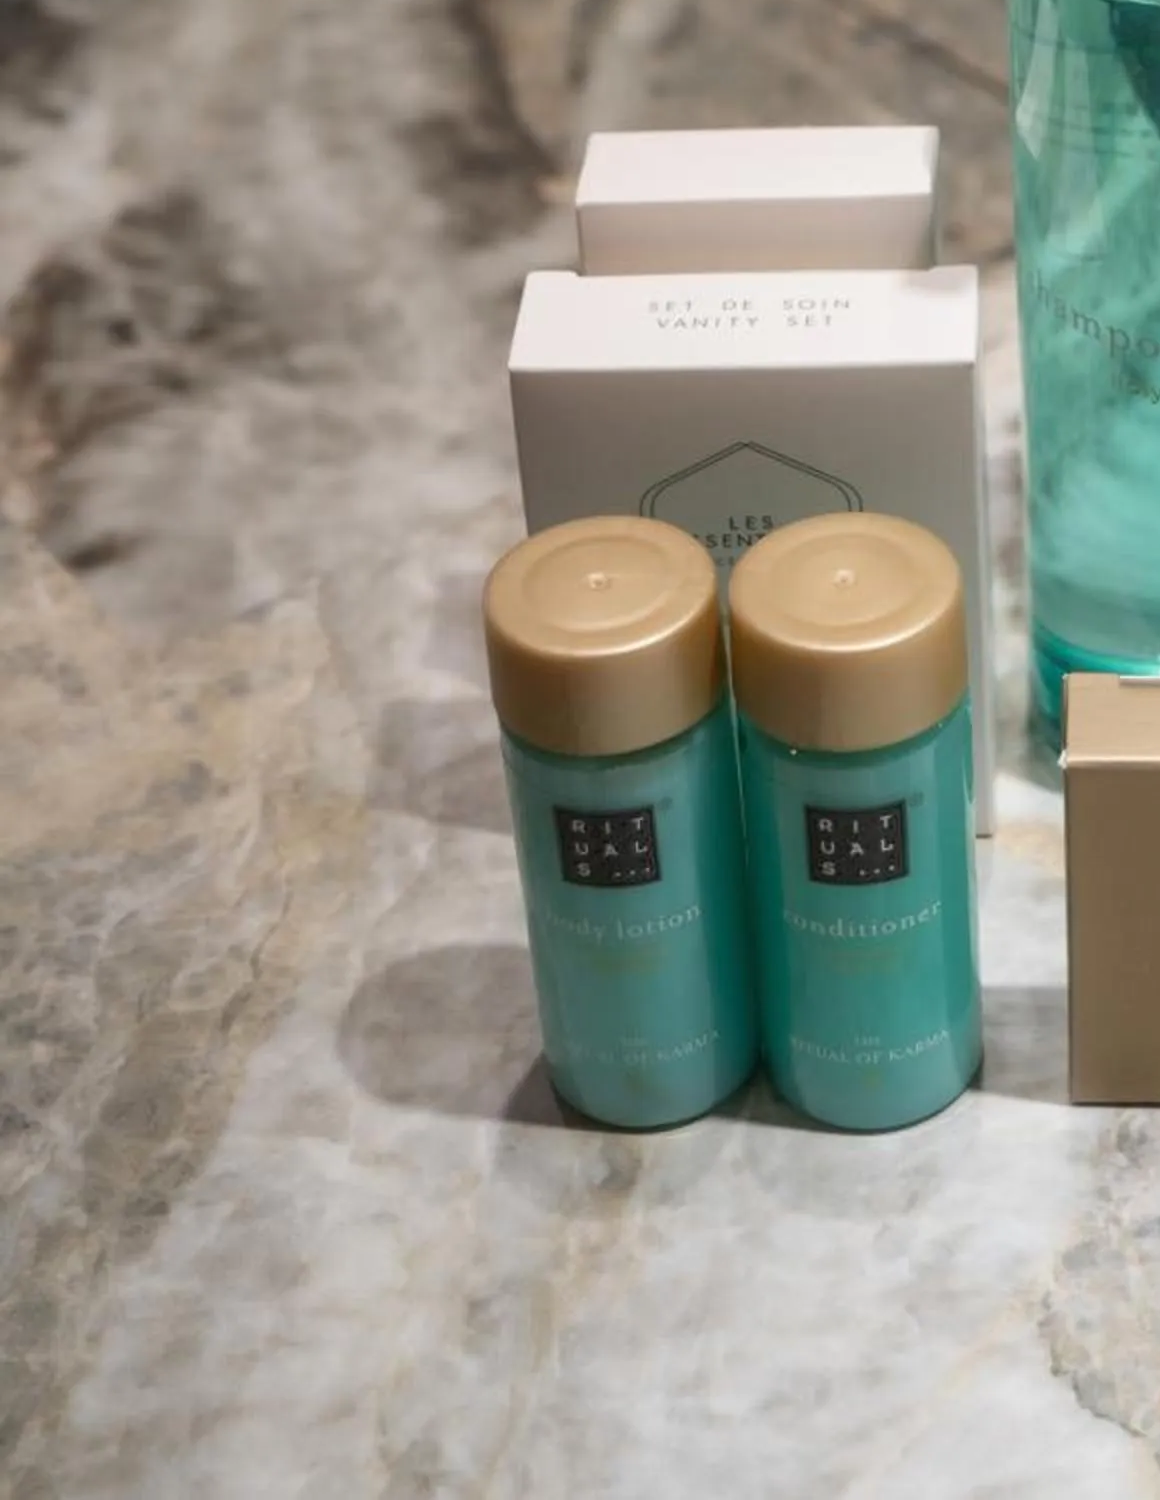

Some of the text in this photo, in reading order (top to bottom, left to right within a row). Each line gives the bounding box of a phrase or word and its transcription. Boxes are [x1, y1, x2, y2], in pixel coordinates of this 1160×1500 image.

[648, 298, 851, 313] SET DE SOIN
[656, 314, 835, 329] VANITY SET
[729, 515, 774, 531] LES
[616, 904, 701, 940] lotion
[783, 900, 942, 938] conditioner
